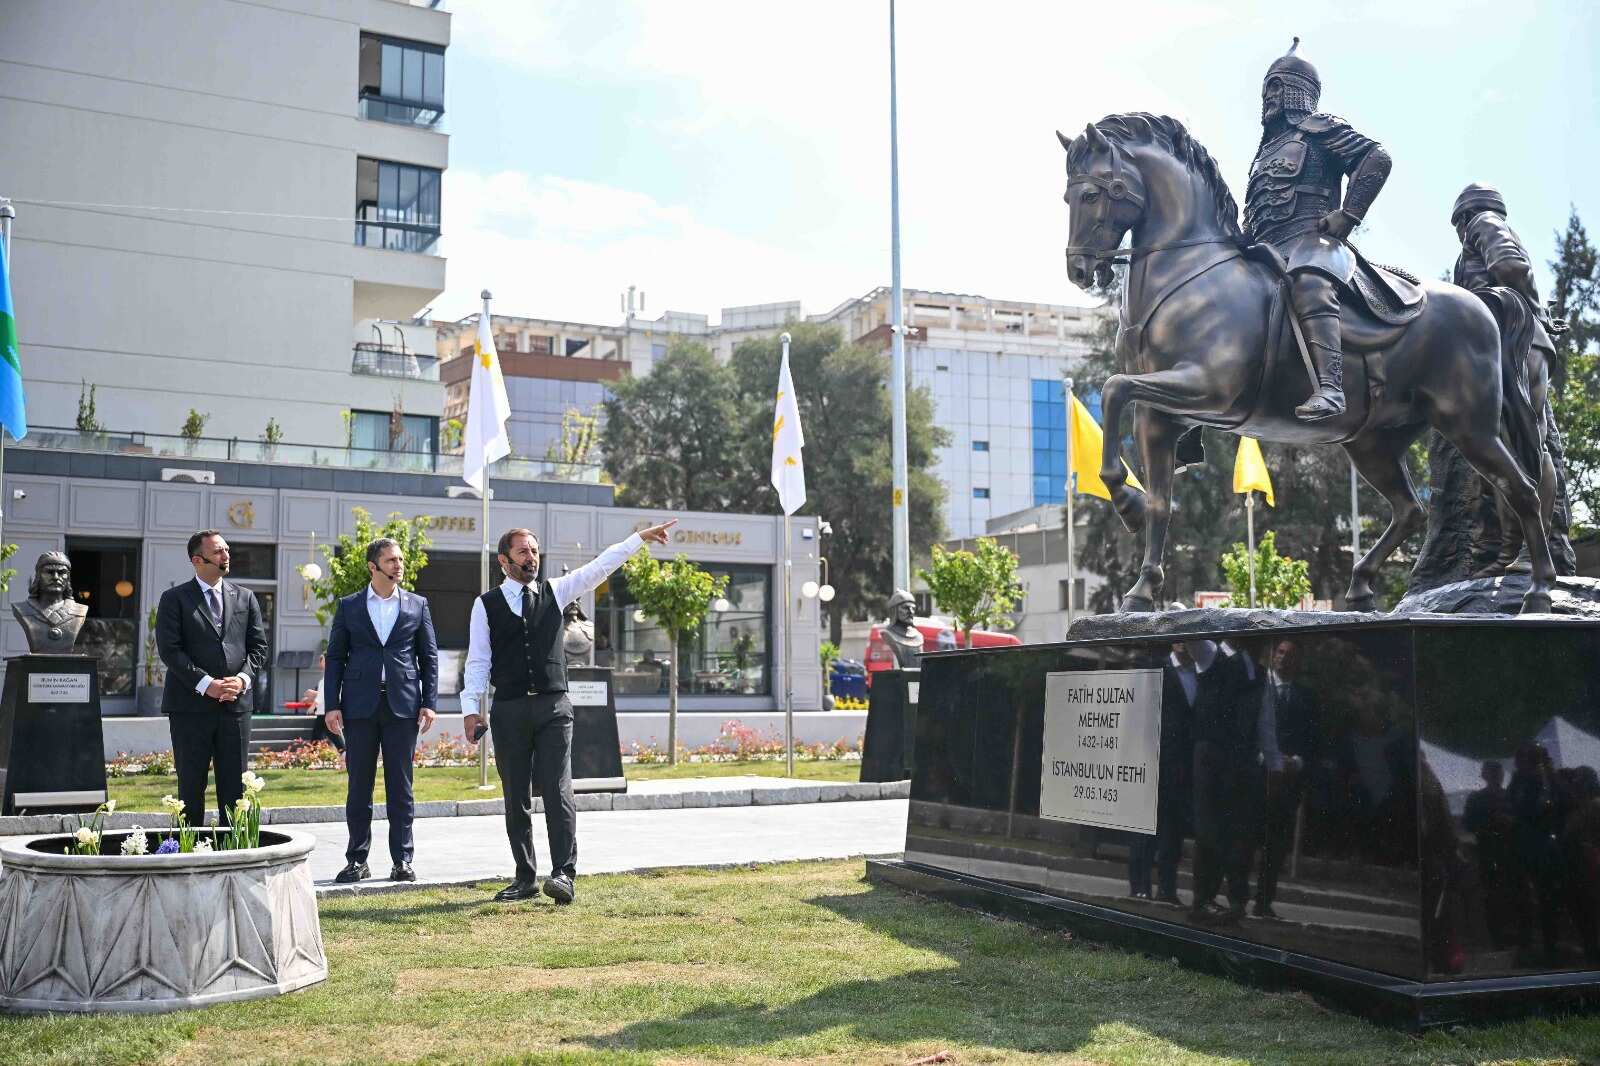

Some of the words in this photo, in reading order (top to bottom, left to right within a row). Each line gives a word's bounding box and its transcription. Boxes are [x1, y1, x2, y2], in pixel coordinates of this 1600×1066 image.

[1067, 684, 1093, 703] FATİH
[1096, 687, 1135, 703] SULTAN
[1078, 712, 1120, 728] MEHMET
[1078, 735, 1119, 749] 1432-1481
[1052, 756, 1113, 780] İSTANBUL'UN
[1117, 762, 1146, 784] FETHİ
[1073, 785, 1118, 802] 29.05.1453
